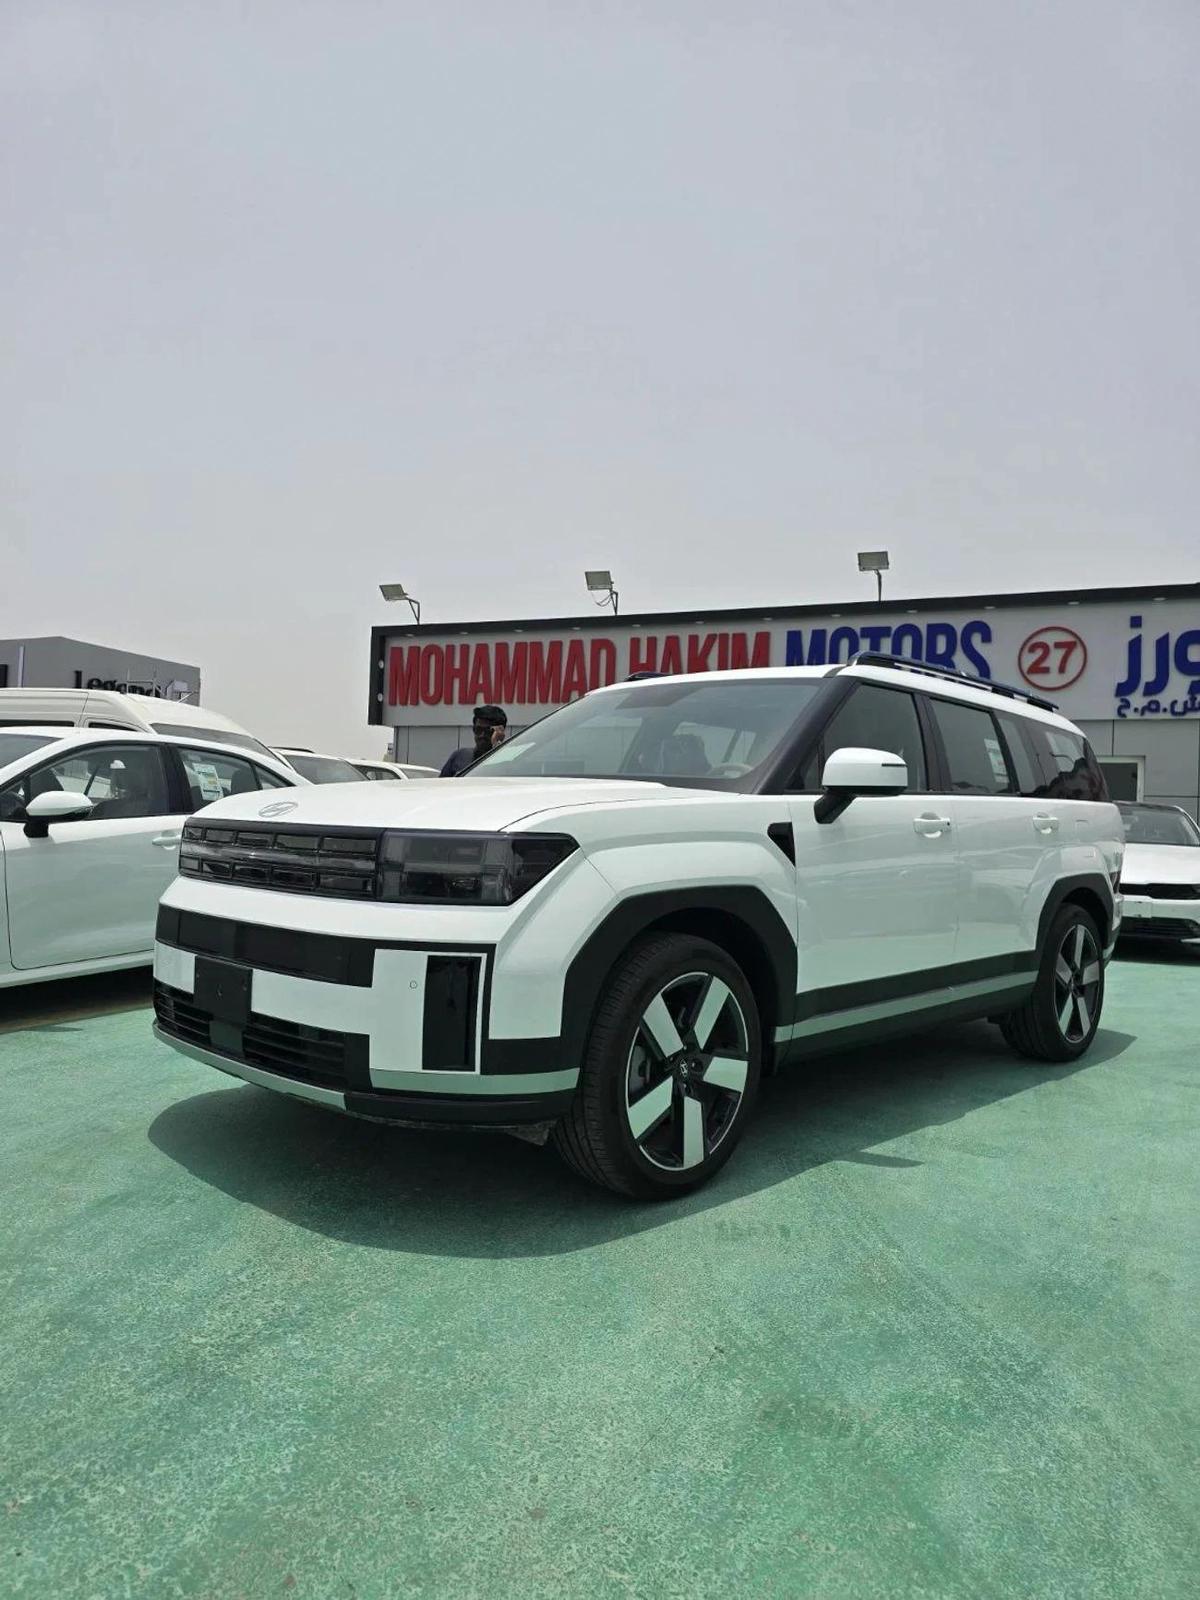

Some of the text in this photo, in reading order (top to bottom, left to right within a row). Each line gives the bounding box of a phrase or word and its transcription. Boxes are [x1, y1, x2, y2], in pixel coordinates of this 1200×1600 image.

[388, 638, 617, 706] MOHAMMAD
[629, 631, 771, 674] HAKIM
[1027, 641, 1077, 675] 27
